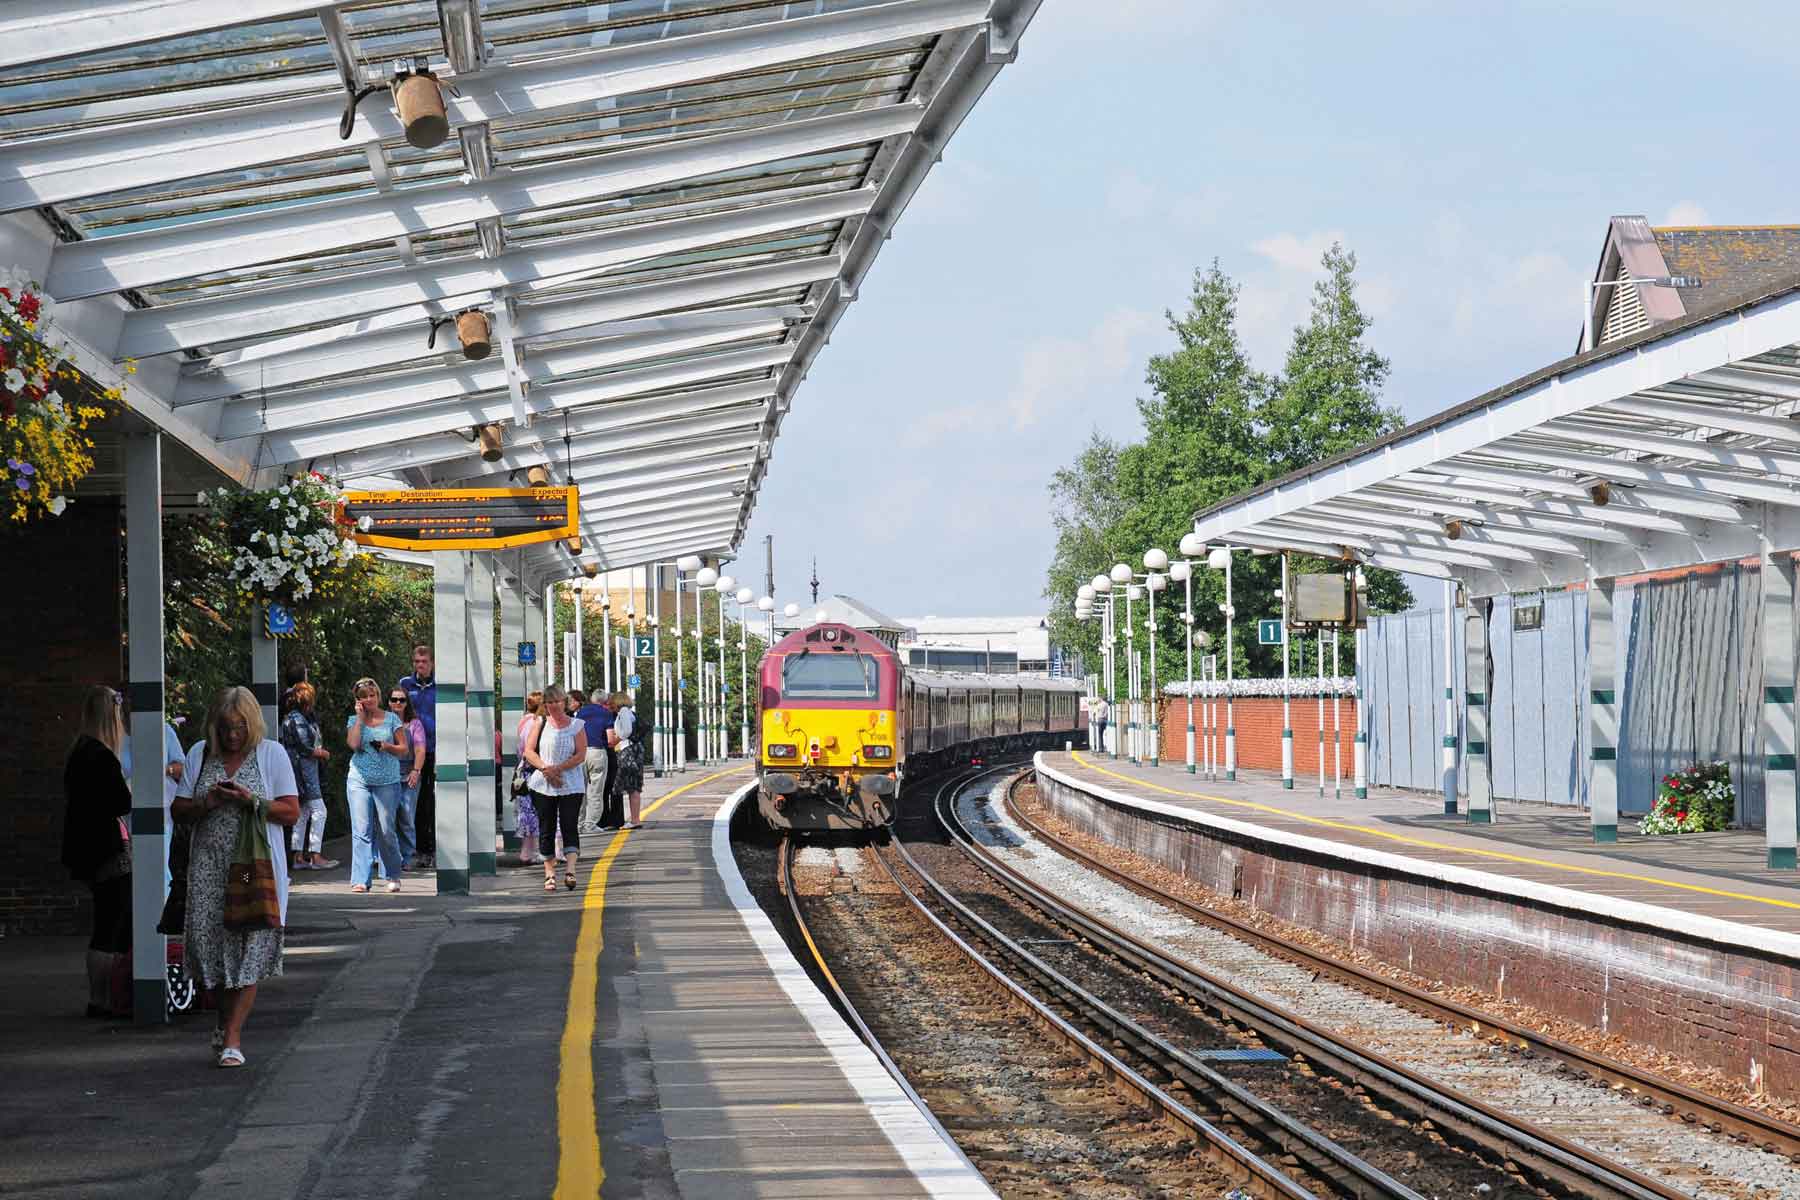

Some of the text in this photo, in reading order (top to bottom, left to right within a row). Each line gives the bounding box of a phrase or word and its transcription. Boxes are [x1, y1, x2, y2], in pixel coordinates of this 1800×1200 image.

[400, 490, 443, 498] Destination
[1268, 623, 1274, 641] 1
[523, 645, 530, 657] 4
[640, 639, 651, 655] 2
